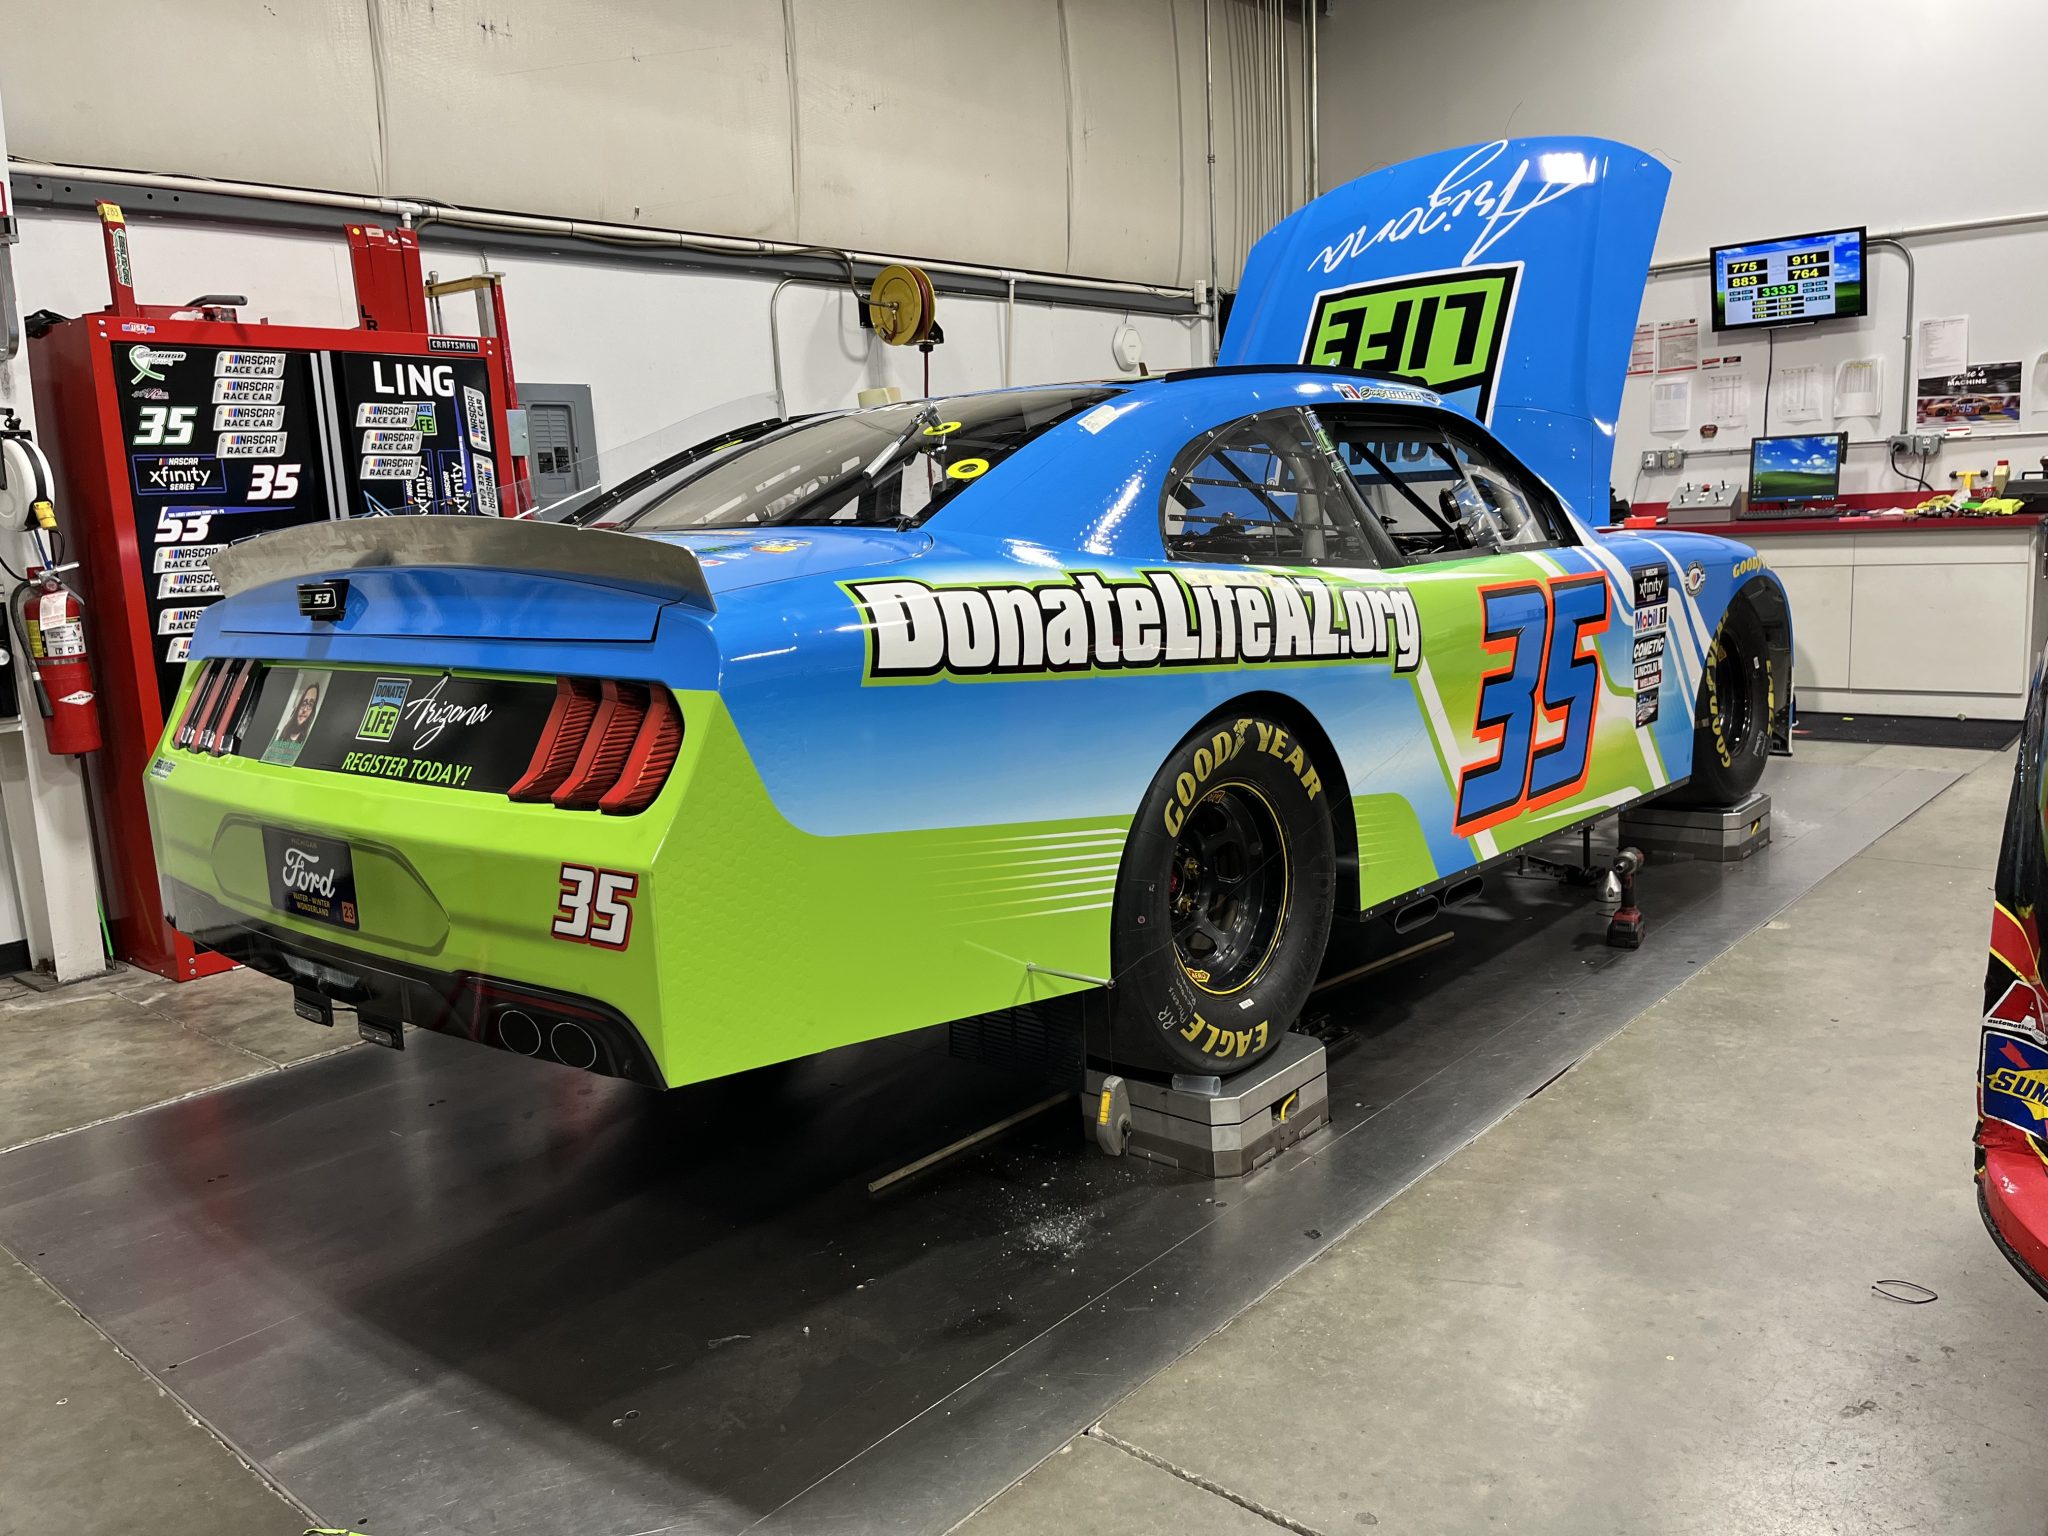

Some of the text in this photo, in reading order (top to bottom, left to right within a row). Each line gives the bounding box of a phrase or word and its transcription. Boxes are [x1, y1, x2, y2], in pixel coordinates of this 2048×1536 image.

[1307, 140, 1582, 272] Arizona
[1732, 262, 1757, 273] 775
[1792, 254, 1817, 265] 911
[1732, 276, 1757, 287] 883
[1792, 268, 1818, 280] 764
[1762, 285, 1796, 297] 3333
[1322, 292, 1487, 372] LIFE
[432, 340, 476, 350] CRAFTSMAN
[238, 355, 276, 365] NASCAR
[236, 382, 274, 391] NASCAR
[373, 361, 454, 397] LING
[1948, 378, 1987, 387] MACHINE
[237, 408, 275, 418] NASCAR
[376, 407, 409, 416] NASCAR
[468, 396, 478, 432] NASCAR
[133, 406, 198, 445] 35
[240, 435, 277, 445] NASCAR
[382, 433, 414, 442] NASCAR
[381, 459, 413, 467] NASCAR
[150, 466, 210, 487] xfinity
[247, 464, 301, 500] 35
[443, 471, 452, 497] NASCAR
[478, 487, 487, 506] CAR
[485, 472, 495, 508] NASCAR
[154, 506, 212, 542] 53
[164, 560, 192, 568] RACE
[183, 575, 217, 583] NASCA
[1639, 577, 1663, 598] xfinity
[314, 593, 330, 604] 53
[853, 573, 1419, 676] DonateLifeAZ.org
[1635, 609, 1658, 630] Mobil
[1634, 636, 1665, 659] COMETIC
[1635, 661, 1658, 680] LINCOLN
[1639, 674, 1660, 689] WELDERS
[376, 684, 405, 699] DONATE
[1454, 572, 1610, 834] 35
[363, 710, 397, 734] LIFE
[404, 676, 492, 750] Arizona
[341, 751, 472, 786] REGISTER TODAY!
[282, 848, 335, 898] Ford
[292, 892, 330, 908] WATER WINTER
[297, 902, 328, 916] WONDERLAND
[552, 864, 636, 949] 35
[343, 906, 353, 919] 23
[1157, 1005, 1177, 1030] RR
[1988, 1018, 2032, 1032] automotive
[1180, 1012, 1268, 1058] EAGLE
